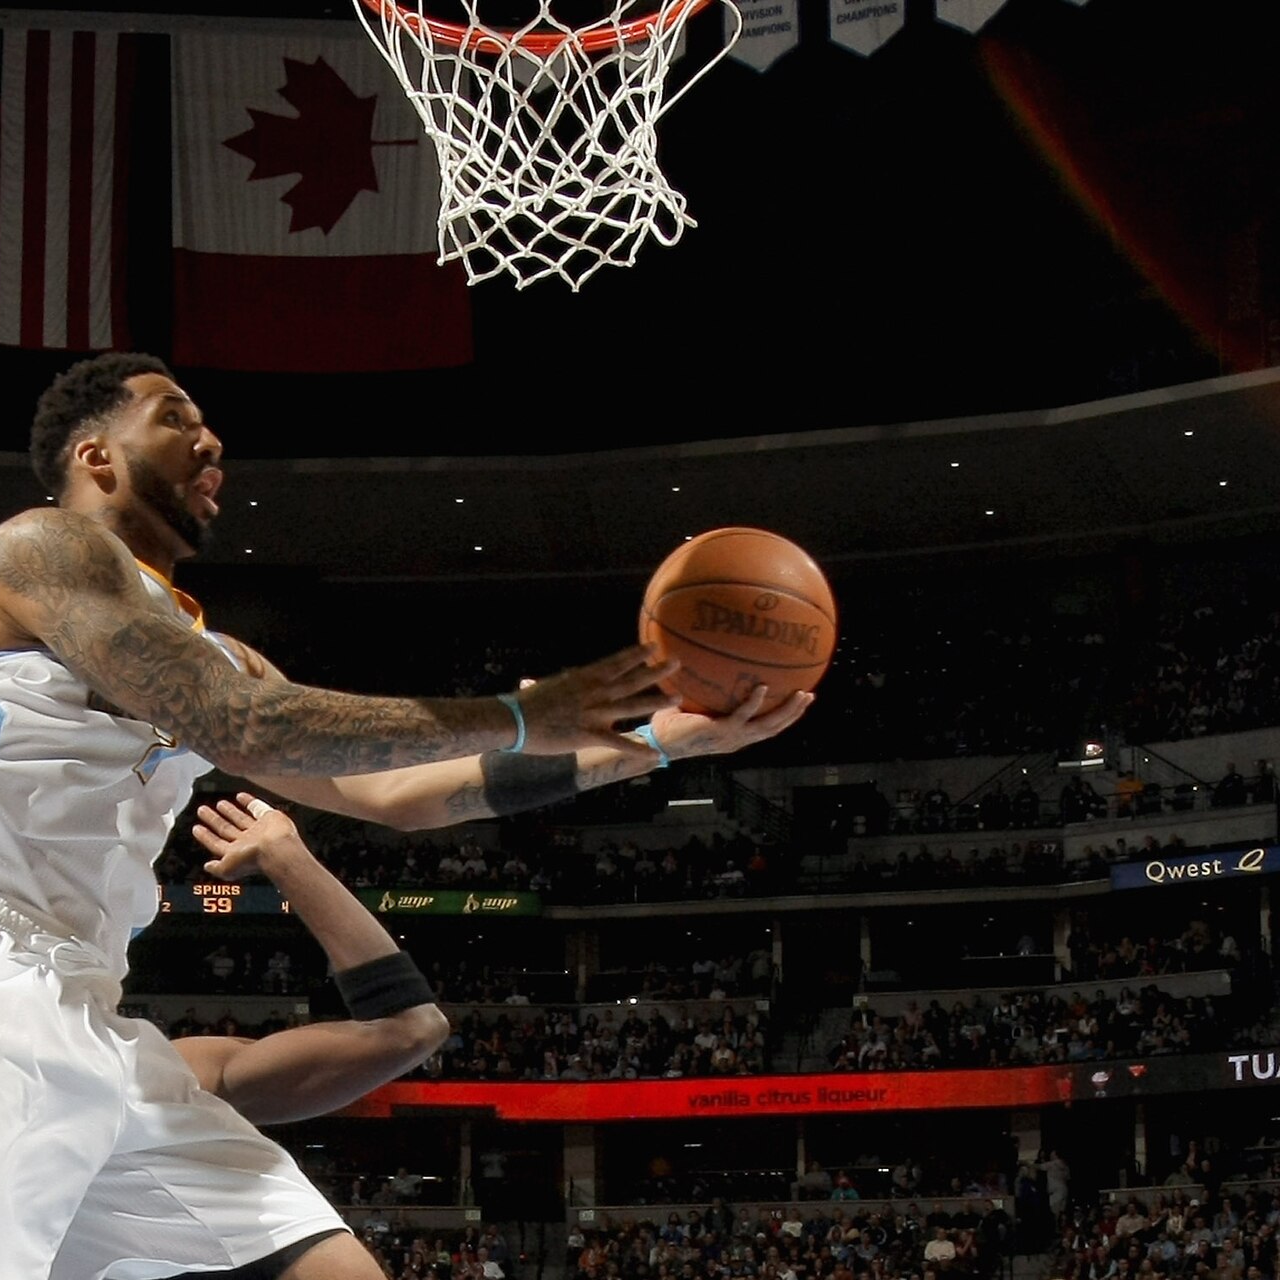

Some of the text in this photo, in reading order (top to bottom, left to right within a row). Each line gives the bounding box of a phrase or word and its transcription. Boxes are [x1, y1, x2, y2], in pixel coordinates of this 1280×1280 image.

[745, 6, 782, 20] IVISION
[837, 3, 897, 24] CHAMPIONS
[743, 22, 791, 38] AMPIONS
[691, 599, 820, 655] SPALDING
[1145, 860, 1225, 882] Qwest
[193, 885, 241, 895] SPURS
[203, 898, 232, 913] 59
[1228, 1053, 1280, 1080] TU
[688, 1091, 751, 1108] vanilla
